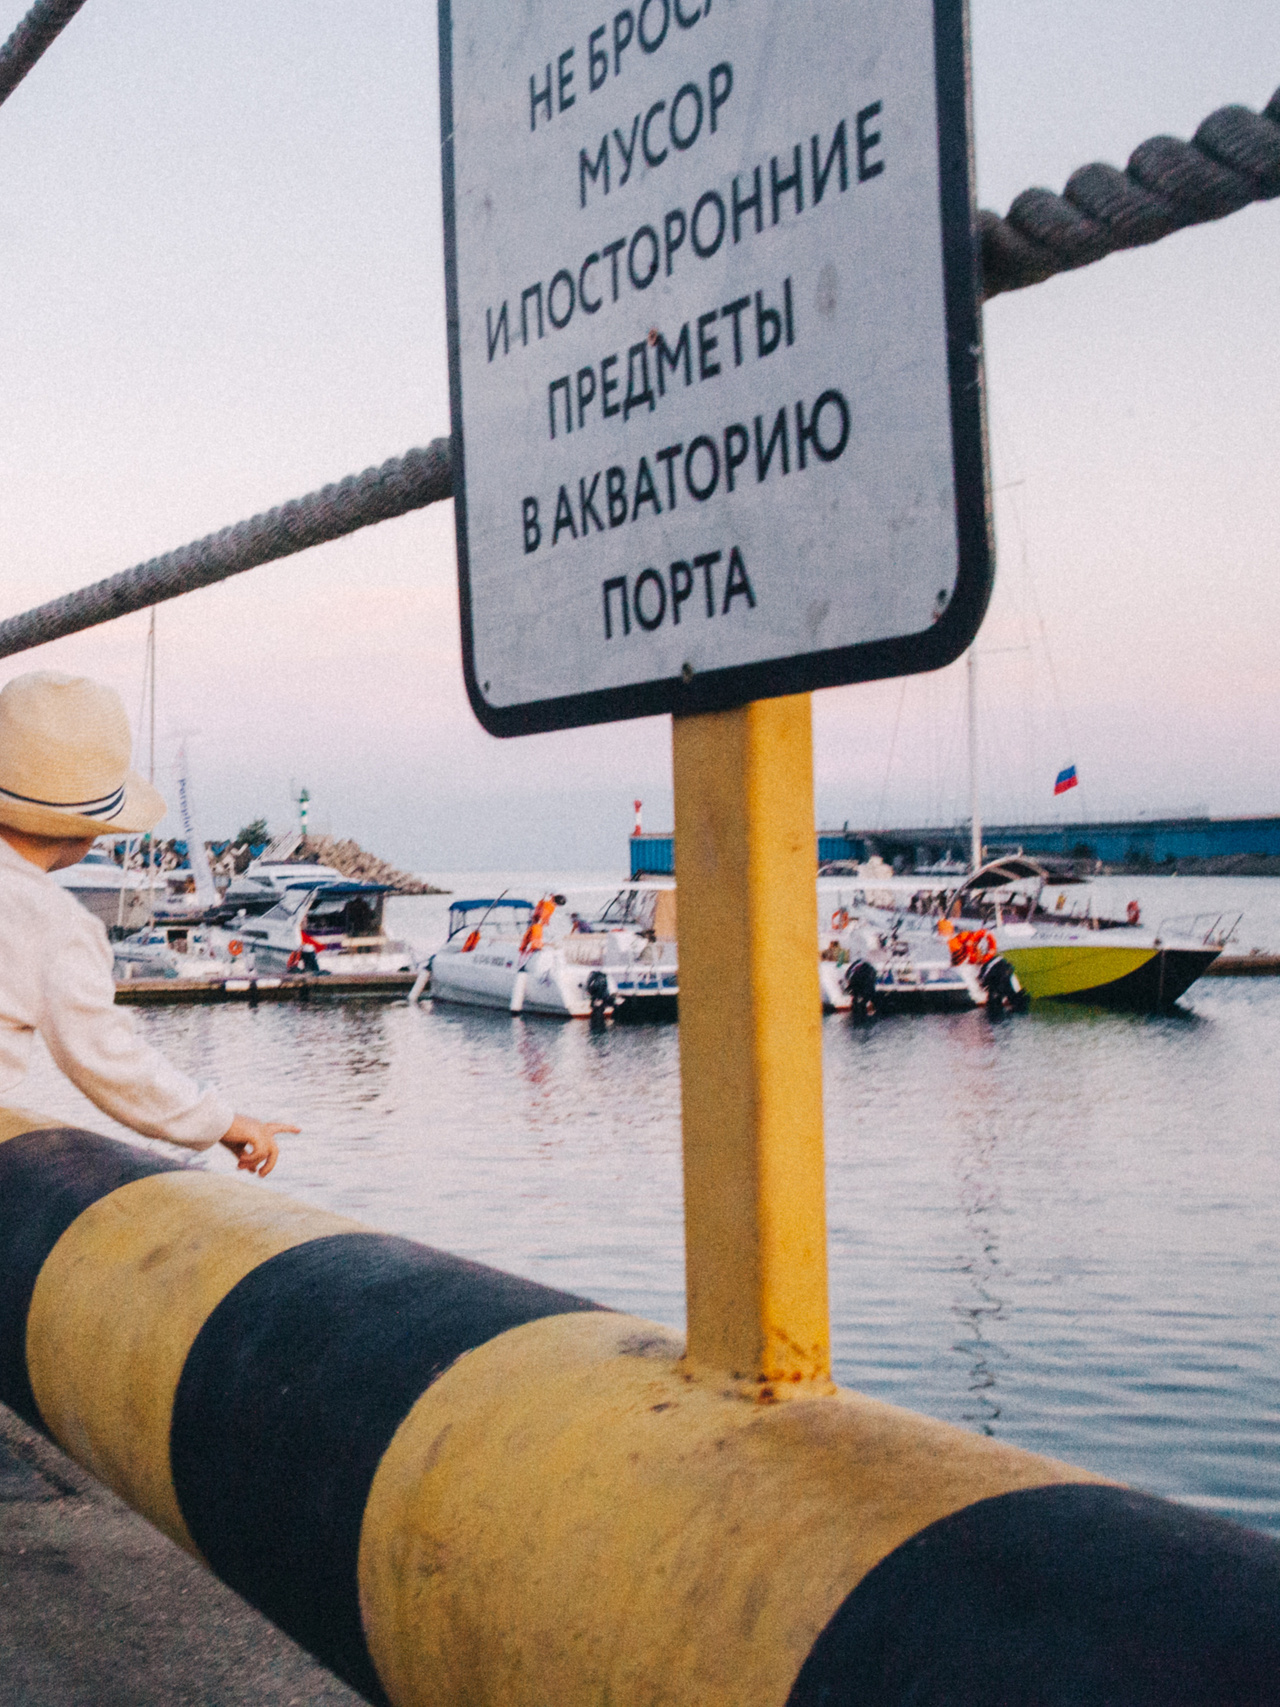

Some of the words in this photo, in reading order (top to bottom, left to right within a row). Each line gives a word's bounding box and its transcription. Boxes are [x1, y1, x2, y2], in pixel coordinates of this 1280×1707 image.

[528, 48, 577, 131] НЕ
[588, 0, 712, 93] БРОС
[579, 62, 734, 208] МУСОР
[486, 300, 510, 362] И
[521, 101, 885, 346] ПОСТОРОННИЕ
[548, 277, 795, 439] ПРЕДМЕТЫ
[523, 495, 542, 553] В
[552, 388, 851, 546] АКВАТОРИЮ
[603, 546, 756, 639] ПОРТА
